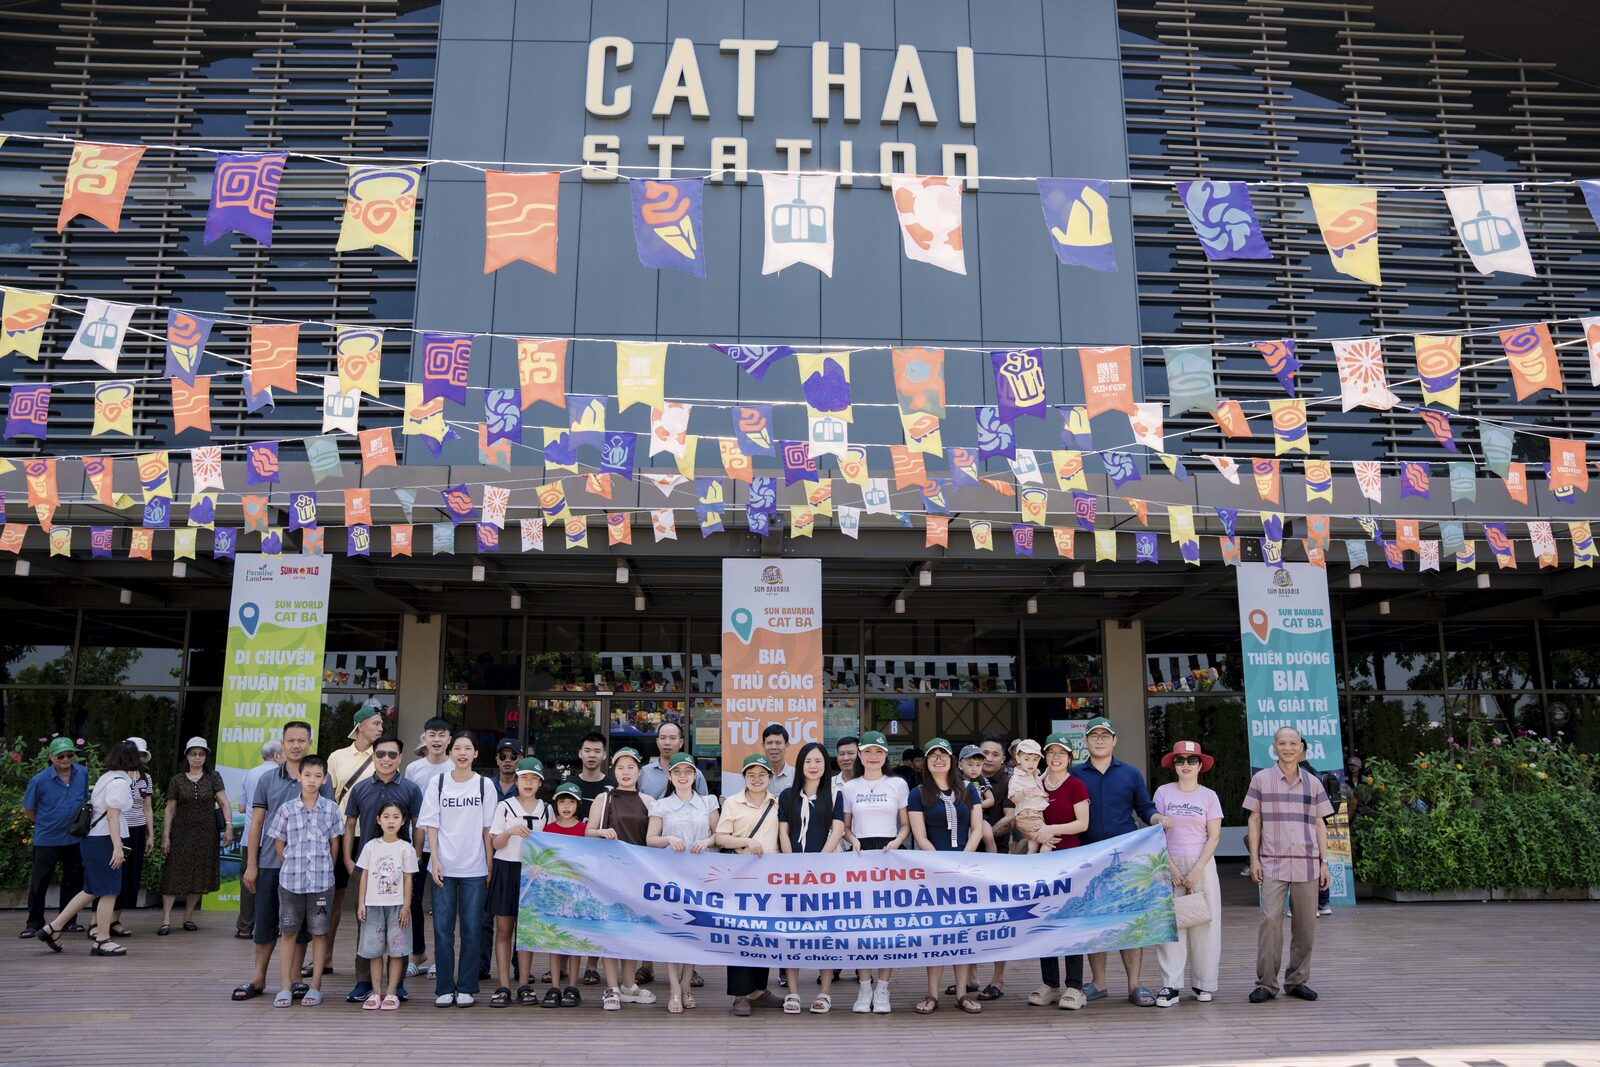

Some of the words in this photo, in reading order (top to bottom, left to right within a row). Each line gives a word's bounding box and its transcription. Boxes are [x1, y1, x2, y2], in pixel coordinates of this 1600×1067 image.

[585, 36, 780, 121] CAT
[812, 41, 977, 127] HAI
[581, 135, 979, 192] STATION
[274, 600, 291, 609] SUN
[294, 600, 323, 609] WORLD
[764, 607, 780, 615] SUN
[781, 607, 814, 615] BAVARIA
[274, 612, 296, 622] CAT
[300, 612, 318, 622] BA
[768, 617, 791, 627] CAT
[795, 617, 813, 627] BA
[1282, 618, 1303, 628] CAT
[1307, 618, 1323, 628] BA
[235, 650, 249, 665] DI
[254, 643, 315, 666] CHUYỂN
[758, 649, 786, 665] BIA
[1248, 650, 1283, 665] THIÊN
[228, 674, 279, 693] THUẬN
[283, 673, 315, 693] TIỆN
[732, 670, 763, 690] THỦ
[768, 672, 814, 690] CÔNG
[1273, 670, 1309, 692] BIA
[234, 703, 260, 718] VUI
[265, 703, 306, 719] TRỌN
[726, 695, 784, 713] NGUYÊN
[788, 695, 817, 713] BẢN
[1257, 697, 1275, 712] VÀ
[1279, 696, 1305, 712] GIẢI
[1308, 696, 1328, 712] TRÍ
[222, 724, 265, 743] HÀNH
[727, 716, 760, 745] TỪ
[767, 716, 818, 745] ỨC
[1295, 713, 1338, 736] NHẤT
[442, 797, 481, 808] CELINE
[767, 869, 836, 885] CHÀO
[846, 867, 926, 883] MỪNG
[643, 881, 724, 909] CÔNG
[734, 893, 772, 912] TY
[781, 890, 862, 912] TNHH
[873, 884, 978, 909] HOÀNG
[988, 877, 1072, 903] NGÂN
[712, 915, 767, 930] THAM
[774, 919, 828, 933] QUAN
[894, 913, 933, 928] ĐẢO
[940, 910, 978, 926] CÁT
[710, 933, 730, 945] DI
[737, 933, 778, 949] SẢN
[786, 936, 849, 950] THIÊN
[857, 934, 922, 950] NHIÊN
[930, 928, 970, 945] THẾ
[976, 926, 1017, 942] GIỚI
[740, 950, 767, 959] Đơn
[771, 953, 782, 962] vị
[805, 953, 843, 961] chức:
[883, 952, 918, 960] SINH
[922, 948, 975, 959] TRAVEL
